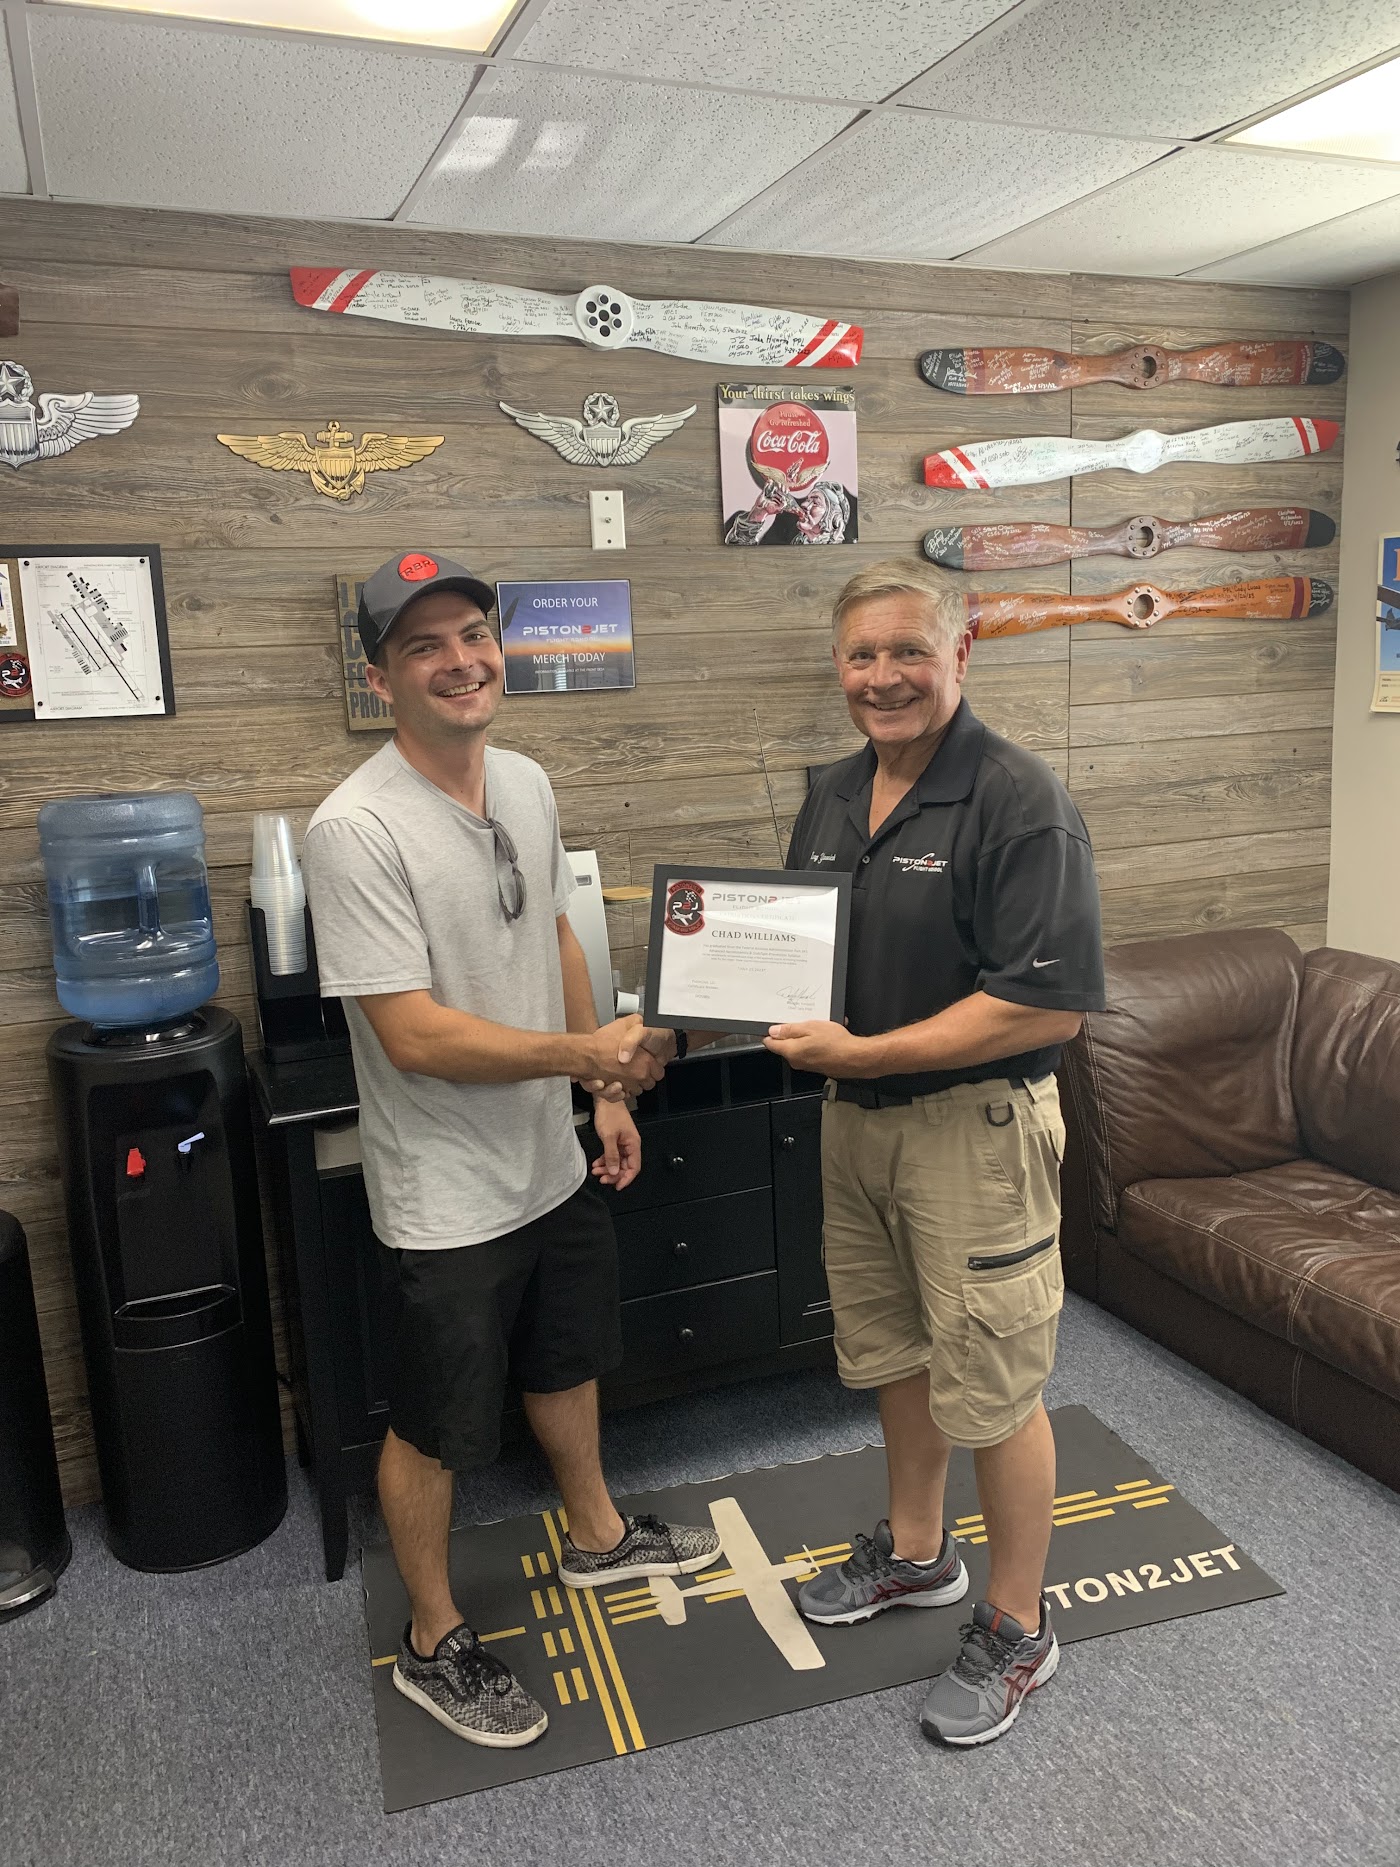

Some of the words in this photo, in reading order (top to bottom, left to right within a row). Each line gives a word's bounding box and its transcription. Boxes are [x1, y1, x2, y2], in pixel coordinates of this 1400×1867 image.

[720, 384, 749, 400] Your
[753, 386, 785, 400] thirst
[790, 387, 820, 401] takes
[823, 389, 856, 404] wings
[781, 418, 811, 427] refreshed
[756, 430, 822, 454] Coca-Cola
[404, 559, 431, 576] RBR
[533, 598, 568, 609] ORDER
[570, 597, 599, 608] YOUR
[523, 624, 619, 636] PISTON2JET
[533, 654, 570, 664] MERCH
[571, 652, 606, 663] TODAY
[892, 856, 948, 867] PISTON2JET
[711, 930, 742, 939] CHAD
[744, 932, 797, 942] WILLIAMS
[1041, 1544, 1242, 1611] TON2JET
